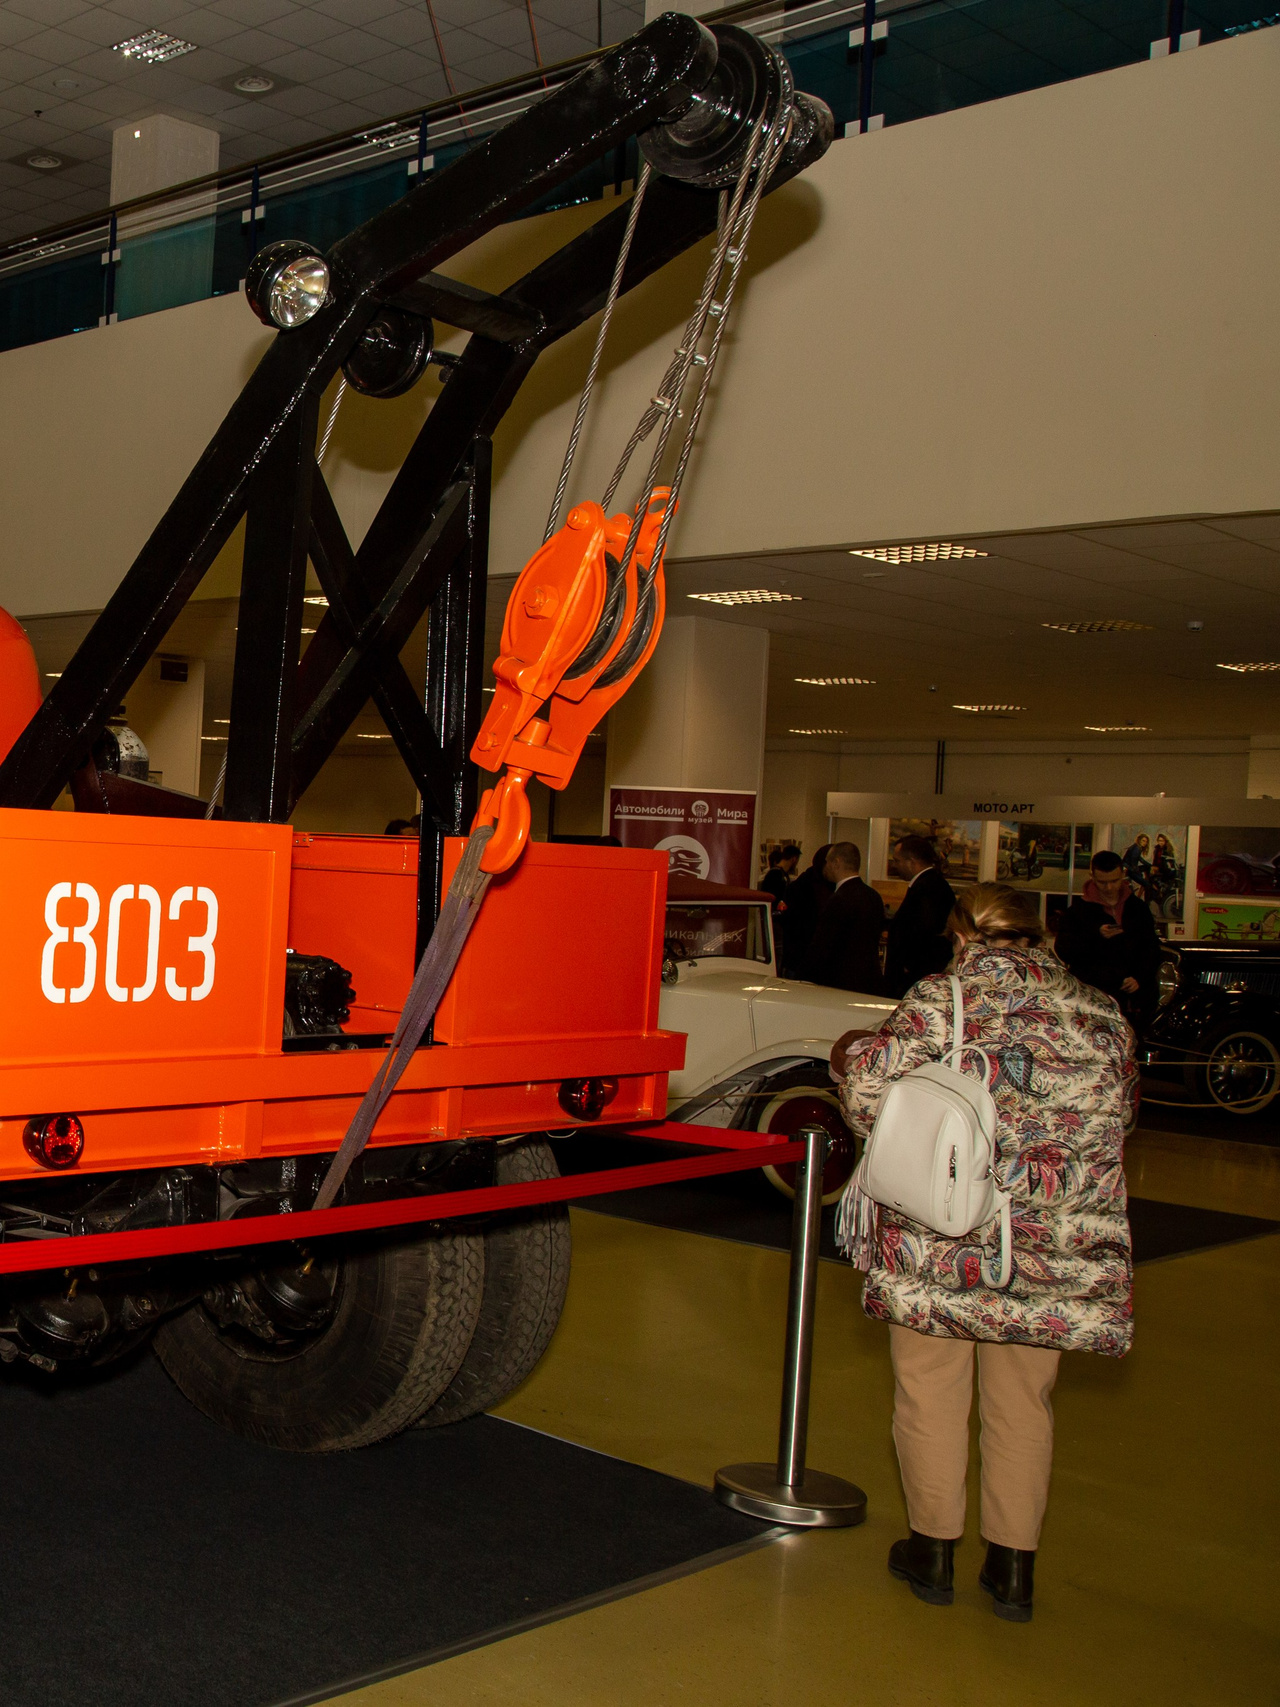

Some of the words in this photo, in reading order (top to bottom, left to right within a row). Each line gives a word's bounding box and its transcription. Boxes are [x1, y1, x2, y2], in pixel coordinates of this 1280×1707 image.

[614, 803, 685, 816] Автомобили
[717, 808, 748, 820] Мира
[40, 882, 219, 1004] 803
